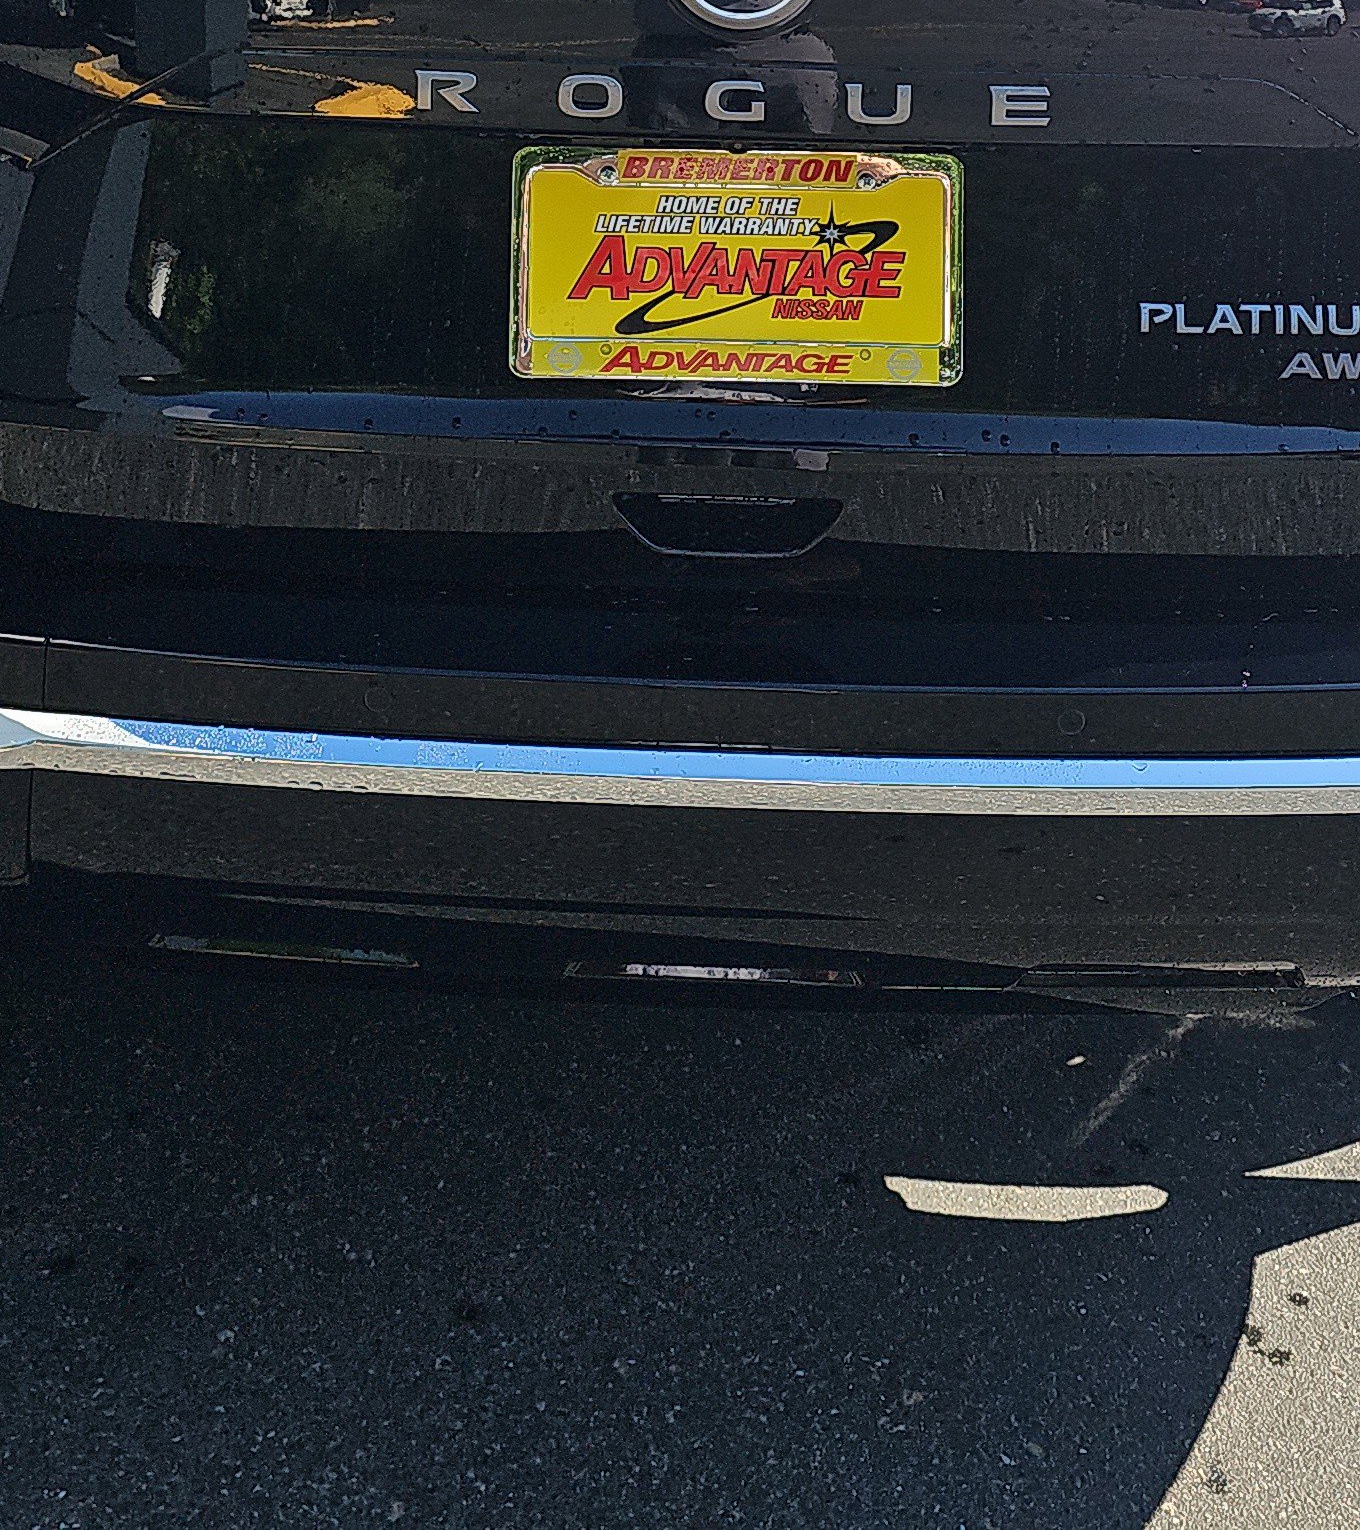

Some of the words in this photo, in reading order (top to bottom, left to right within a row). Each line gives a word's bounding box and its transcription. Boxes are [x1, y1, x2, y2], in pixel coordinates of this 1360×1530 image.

[414, 68, 1053, 128] ROGUE
[622, 155, 855, 183] BREMERTON
[657, 195, 721, 214] HOME
[725, 196, 755, 214] OF
[758, 197, 800, 215] THE
[594, 214, 693, 235] LIFETIME
[700, 216, 820, 236] WARRANTY
[567, 235, 907, 301] ADVANTAGE
[771, 298, 863, 321] NISSAN
[598, 345, 856, 375] ADVANTAGE
